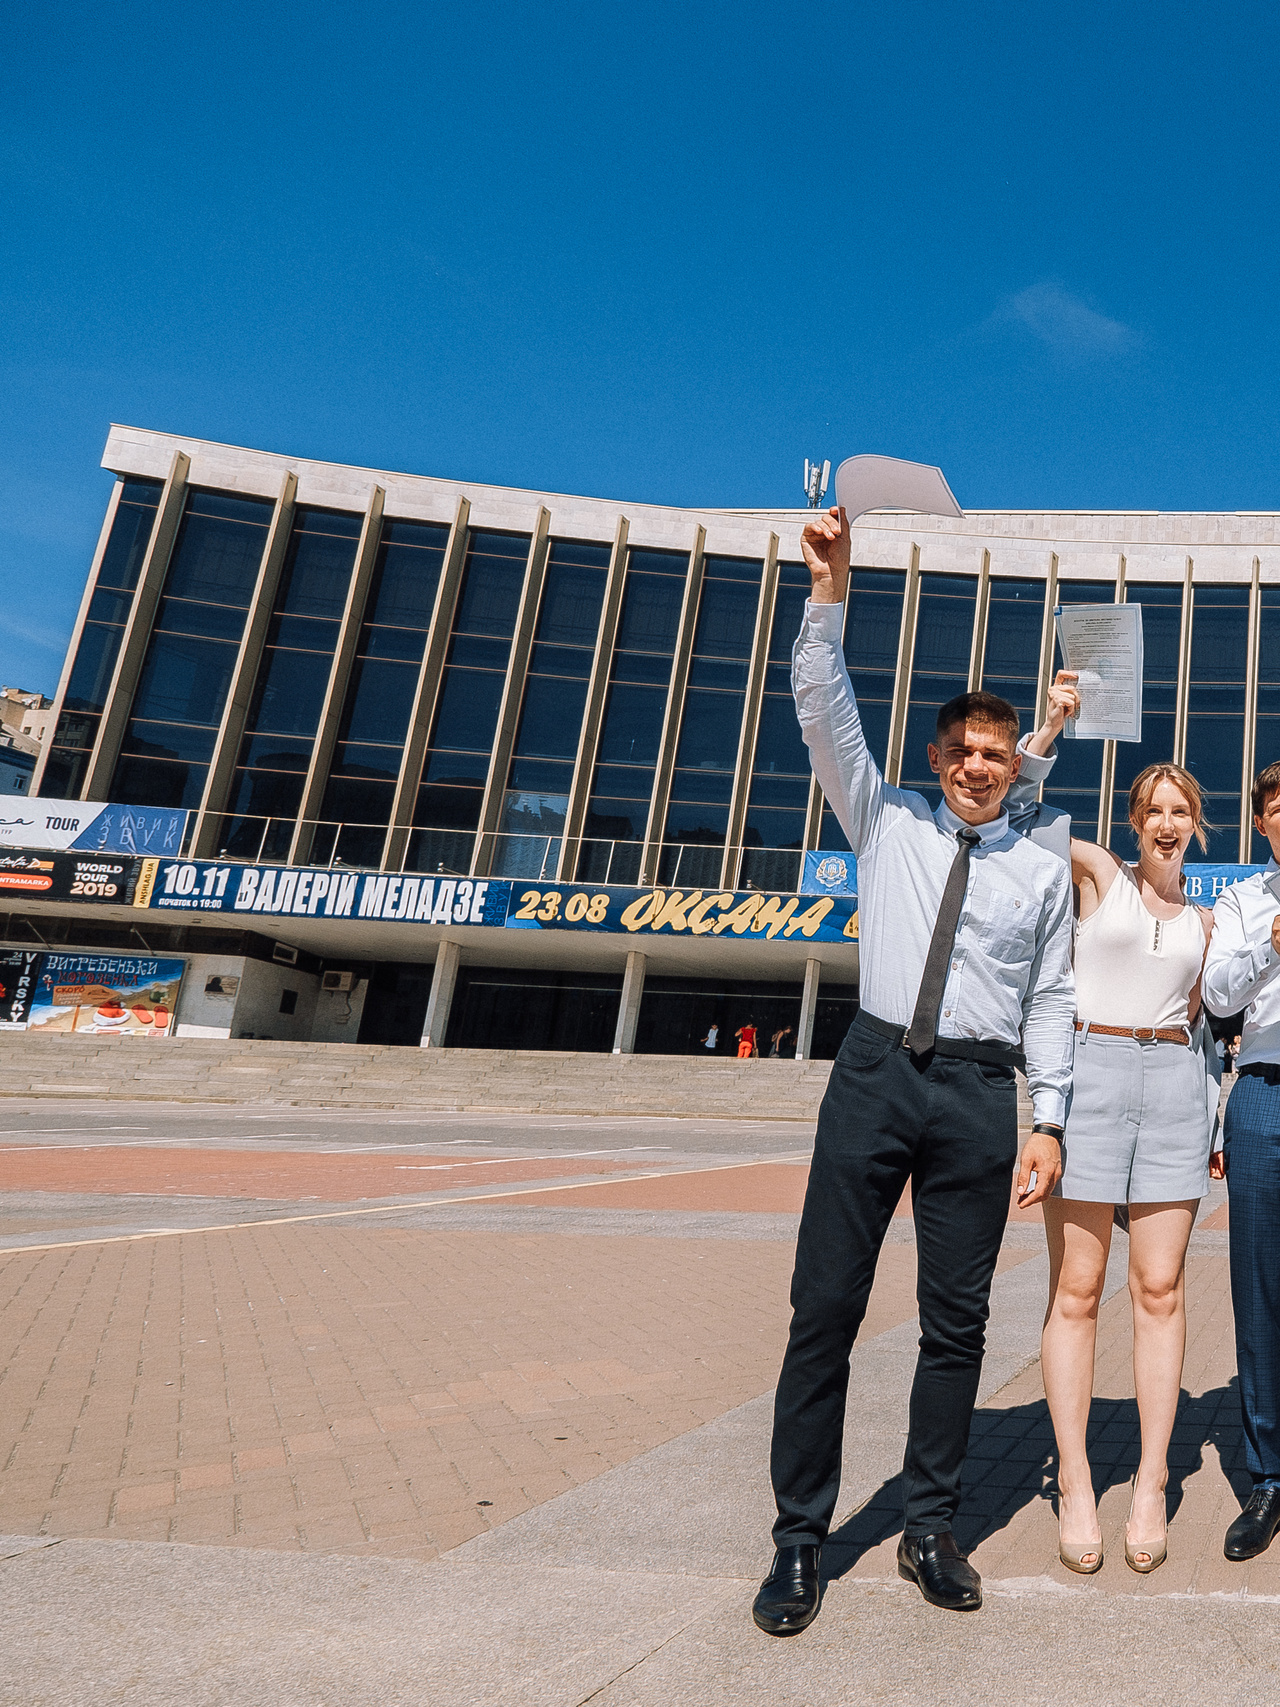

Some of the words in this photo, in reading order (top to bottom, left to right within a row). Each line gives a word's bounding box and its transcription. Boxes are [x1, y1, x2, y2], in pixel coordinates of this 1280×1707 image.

[46, 816, 80, 832] TOUR
[102, 813, 179, 832] ЖИВИЙ
[97, 826, 177, 849] ЗВУК
[74, 872, 109, 883] TOUR
[76, 862, 124, 874] WORLD
[0, 877, 49, 886] NTRAMARKA
[70, 882, 118, 897] 2019
[163, 864, 231, 897] 10.11
[200, 898, 223, 909] 19:00
[358, 875, 489, 925] МЕЛАДЗЕ
[514, 890, 610, 923] 23.08
[620, 889, 835, 940] ОКСАНА
[46, 955, 158, 975] ВИТРЕБЕНЬКИ
[10, 952, 38, 1023] VIRSKY
